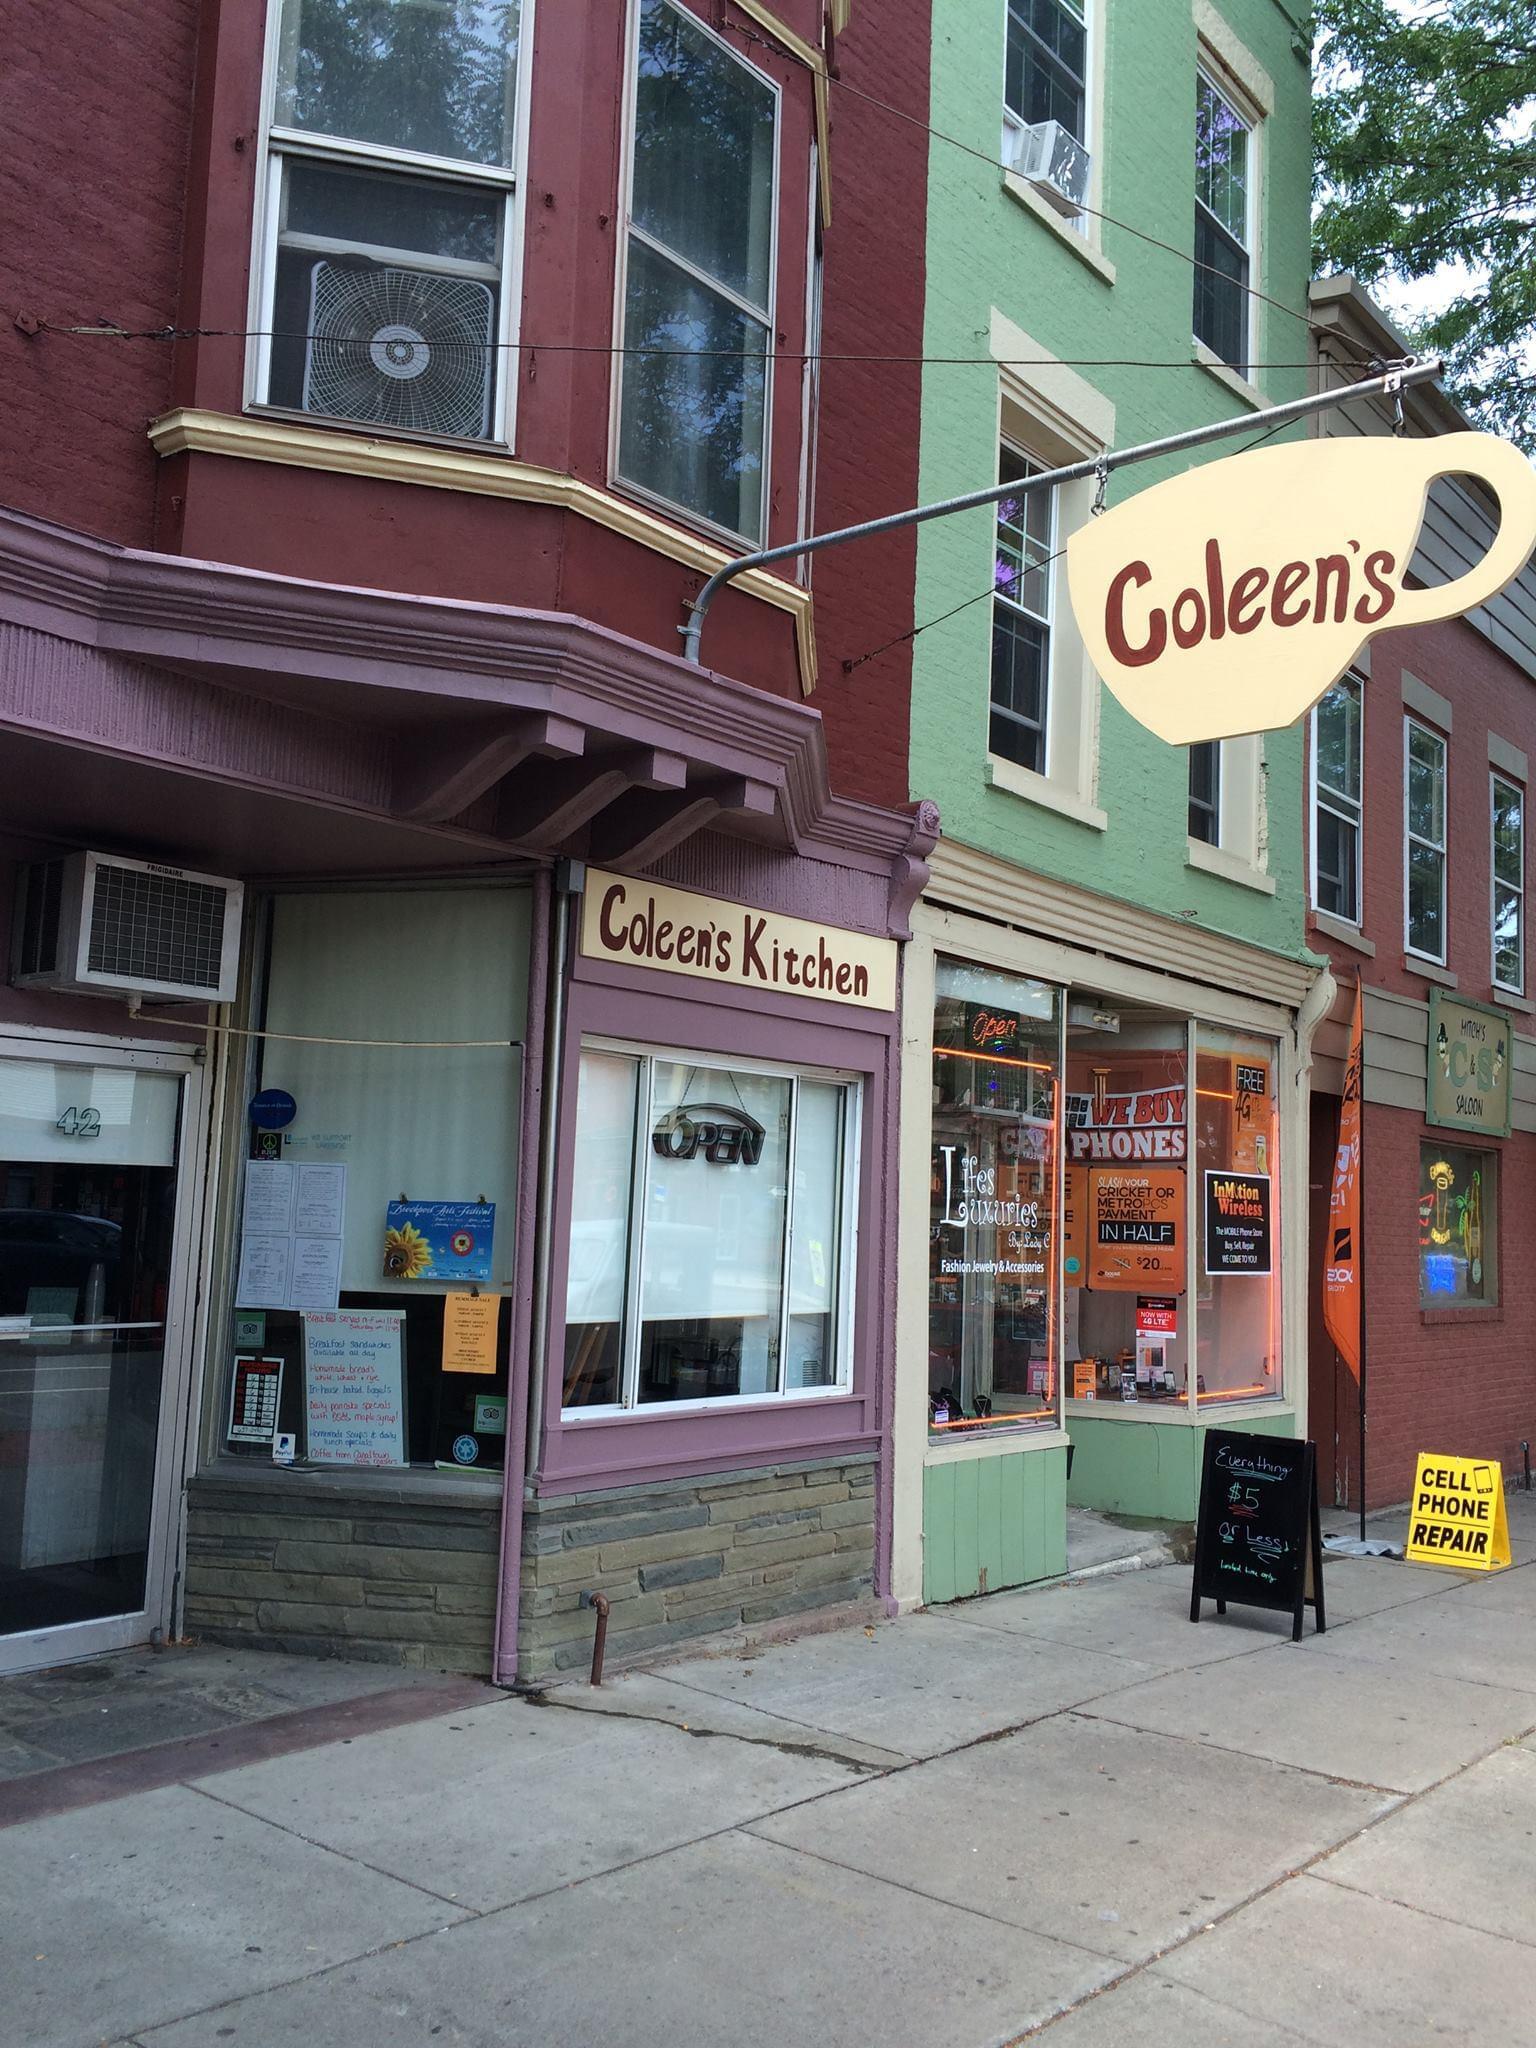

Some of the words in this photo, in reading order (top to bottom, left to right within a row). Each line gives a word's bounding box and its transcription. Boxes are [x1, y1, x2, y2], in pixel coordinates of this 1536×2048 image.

[1105, 538, 1396, 668] Coleen's
[147, 863, 185, 878] FRIGIDAIRE
[600, 884, 732, 972] Coleen's
[742, 914, 869, 997] Kitchen
[972, 1012, 1017, 1047] Open
[1460, 1018, 1486, 1042] MITCH'S
[1449, 1041, 1468, 1088] C
[1470, 1054, 1476, 1076] &
[1477, 1047, 1492, 1093] S
[1237, 1067, 1264, 1092] FREE
[1091, 1097, 1132, 1126] WE
[1133, 1089, 1186, 1124] BUY
[1235, 1090, 1250, 1132] 4G
[1456, 1095, 1483, 1116] SALOON
[57, 1107, 101, 1137] 42
[662, 1117, 766, 1165] OPEN
[1070, 1130, 1186, 1159] PHONES
[1097, 1186, 1153, 1198] CRICKET
[1155, 1187, 1174, 1198] OR
[1126, 1178, 1149, 1187] YOUR
[1213, 1180, 1260, 1200] InMtion
[1097, 1198, 1168, 1210] METROPCS
[1097, 1209, 1156, 1220] PAYMENT
[1218, 1197, 1264, 1217] Wireless
[1023, 1231, 1042, 1255] Lady
[1101, 1224, 1119, 1240] IN
[1124, 1224, 1173, 1242] HALF
[1215, 1226, 1223, 1236] The
[1224, 1228, 1240, 1237] MOBILE
[1240, 1228, 1252, 1237] Phone
[1252, 1228, 1263, 1238] Store
[1241, 1242, 1255, 1252] Repair
[941, 1258, 971, 1274] Fashion
[971, 1259, 998, 1276] Jewelry
[998, 1262, 1005, 1274] &
[1005, 1260, 1044, 1274] Accessories
[1136, 1257, 1160, 1270] $20
[1222, 1254, 1229, 1263] WE
[1230, 1255, 1242, 1263] COME
[1242, 1255, 1248, 1263] TO
[1140, 1311, 1157, 1319] NOW
[1158, 1312, 1172, 1320] WITH
[309, 1337, 345, 1349] Breakfast
[361, 1349, 375, 1359] day
[1215, 1446, 1292, 1480] Everything
[1422, 1468, 1471, 1491] CELL
[1227, 1482, 1260, 1509] $5
[1417, 1493, 1489, 1520] PHONE
[1412, 1523, 1489, 1555] REPAIR
